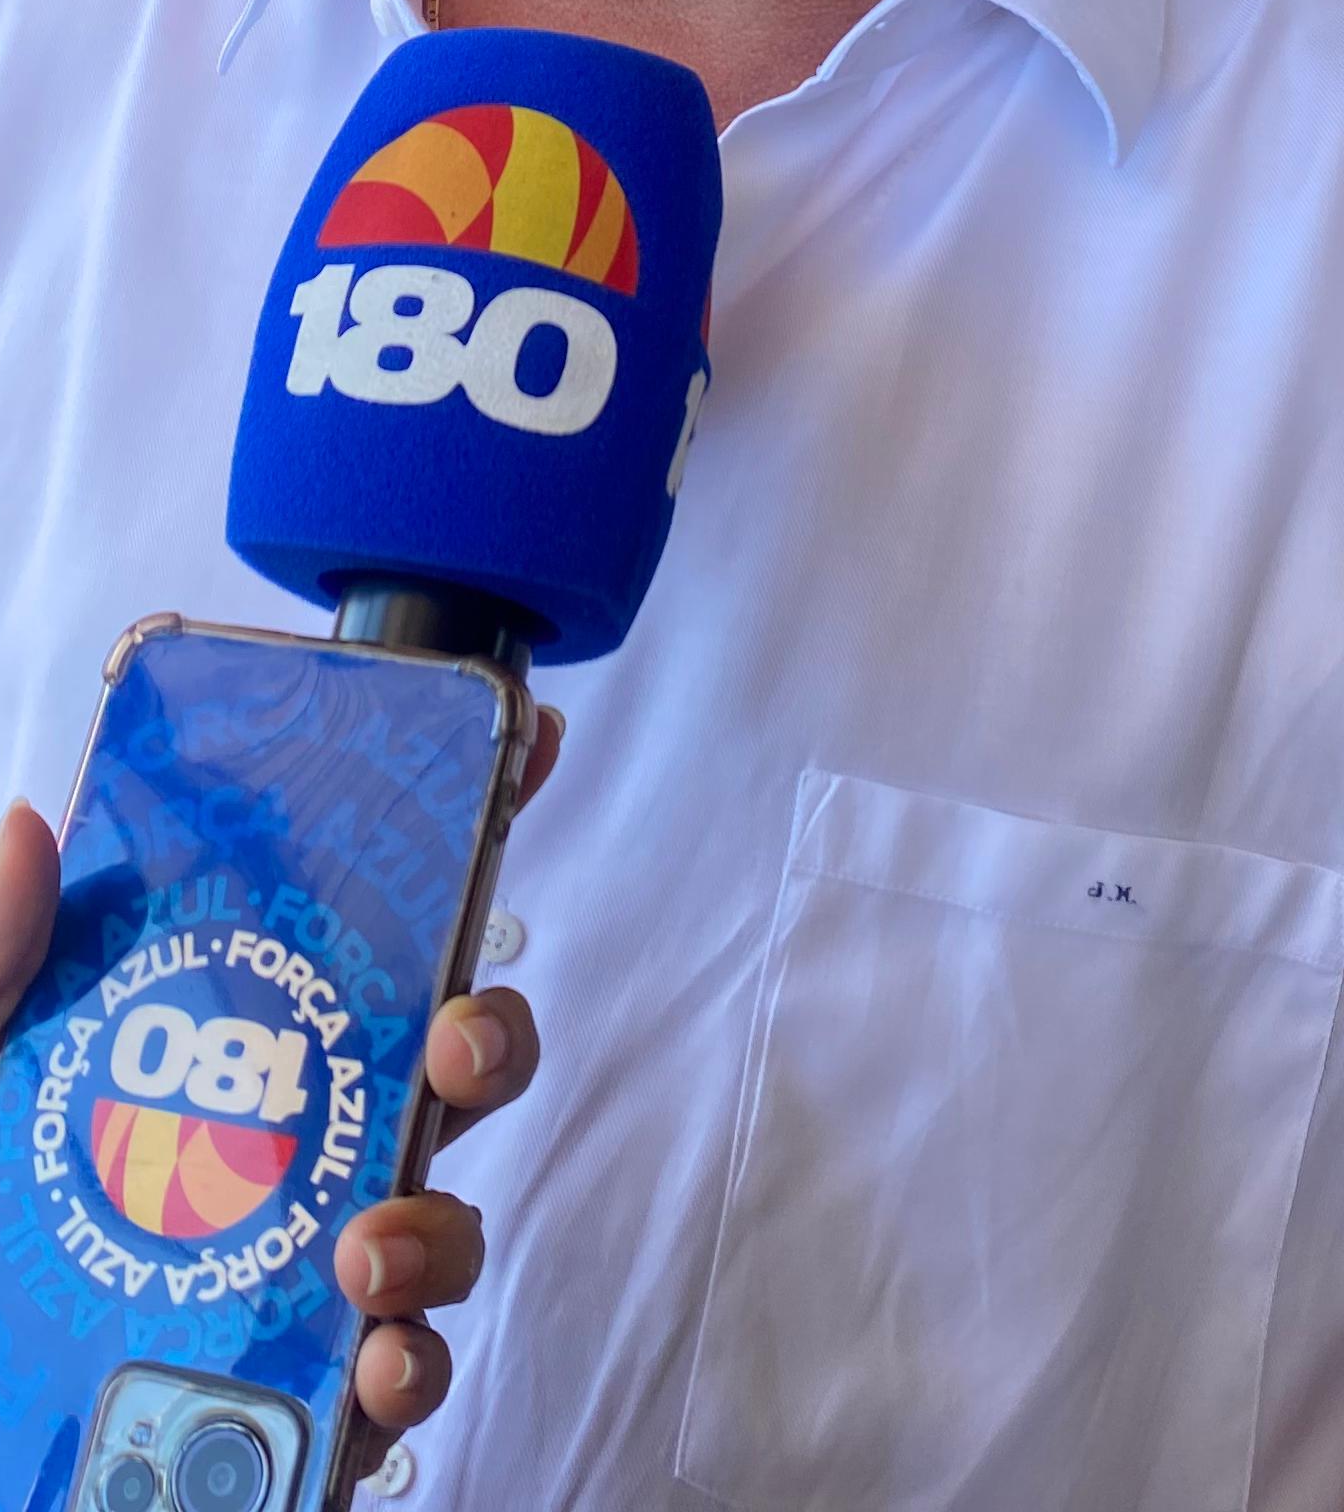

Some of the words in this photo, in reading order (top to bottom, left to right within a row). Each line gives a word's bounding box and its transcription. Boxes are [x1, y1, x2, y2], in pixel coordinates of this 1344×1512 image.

[285, 263, 618, 436] 180
[99, 931, 209, 1017] AZUL
[225, 929, 350, 1050] FORÇA
[32, 1016, 103, 1184] FORÇA
[110, 1002, 308, 1124] 180
[310, 1055, 365, 1185] AZUL
[0, 1194, 116, 1340] AZUL
[56, 1196, 156, 1298] AZUL
[163, 1202, 321, 1305] FORÇA
